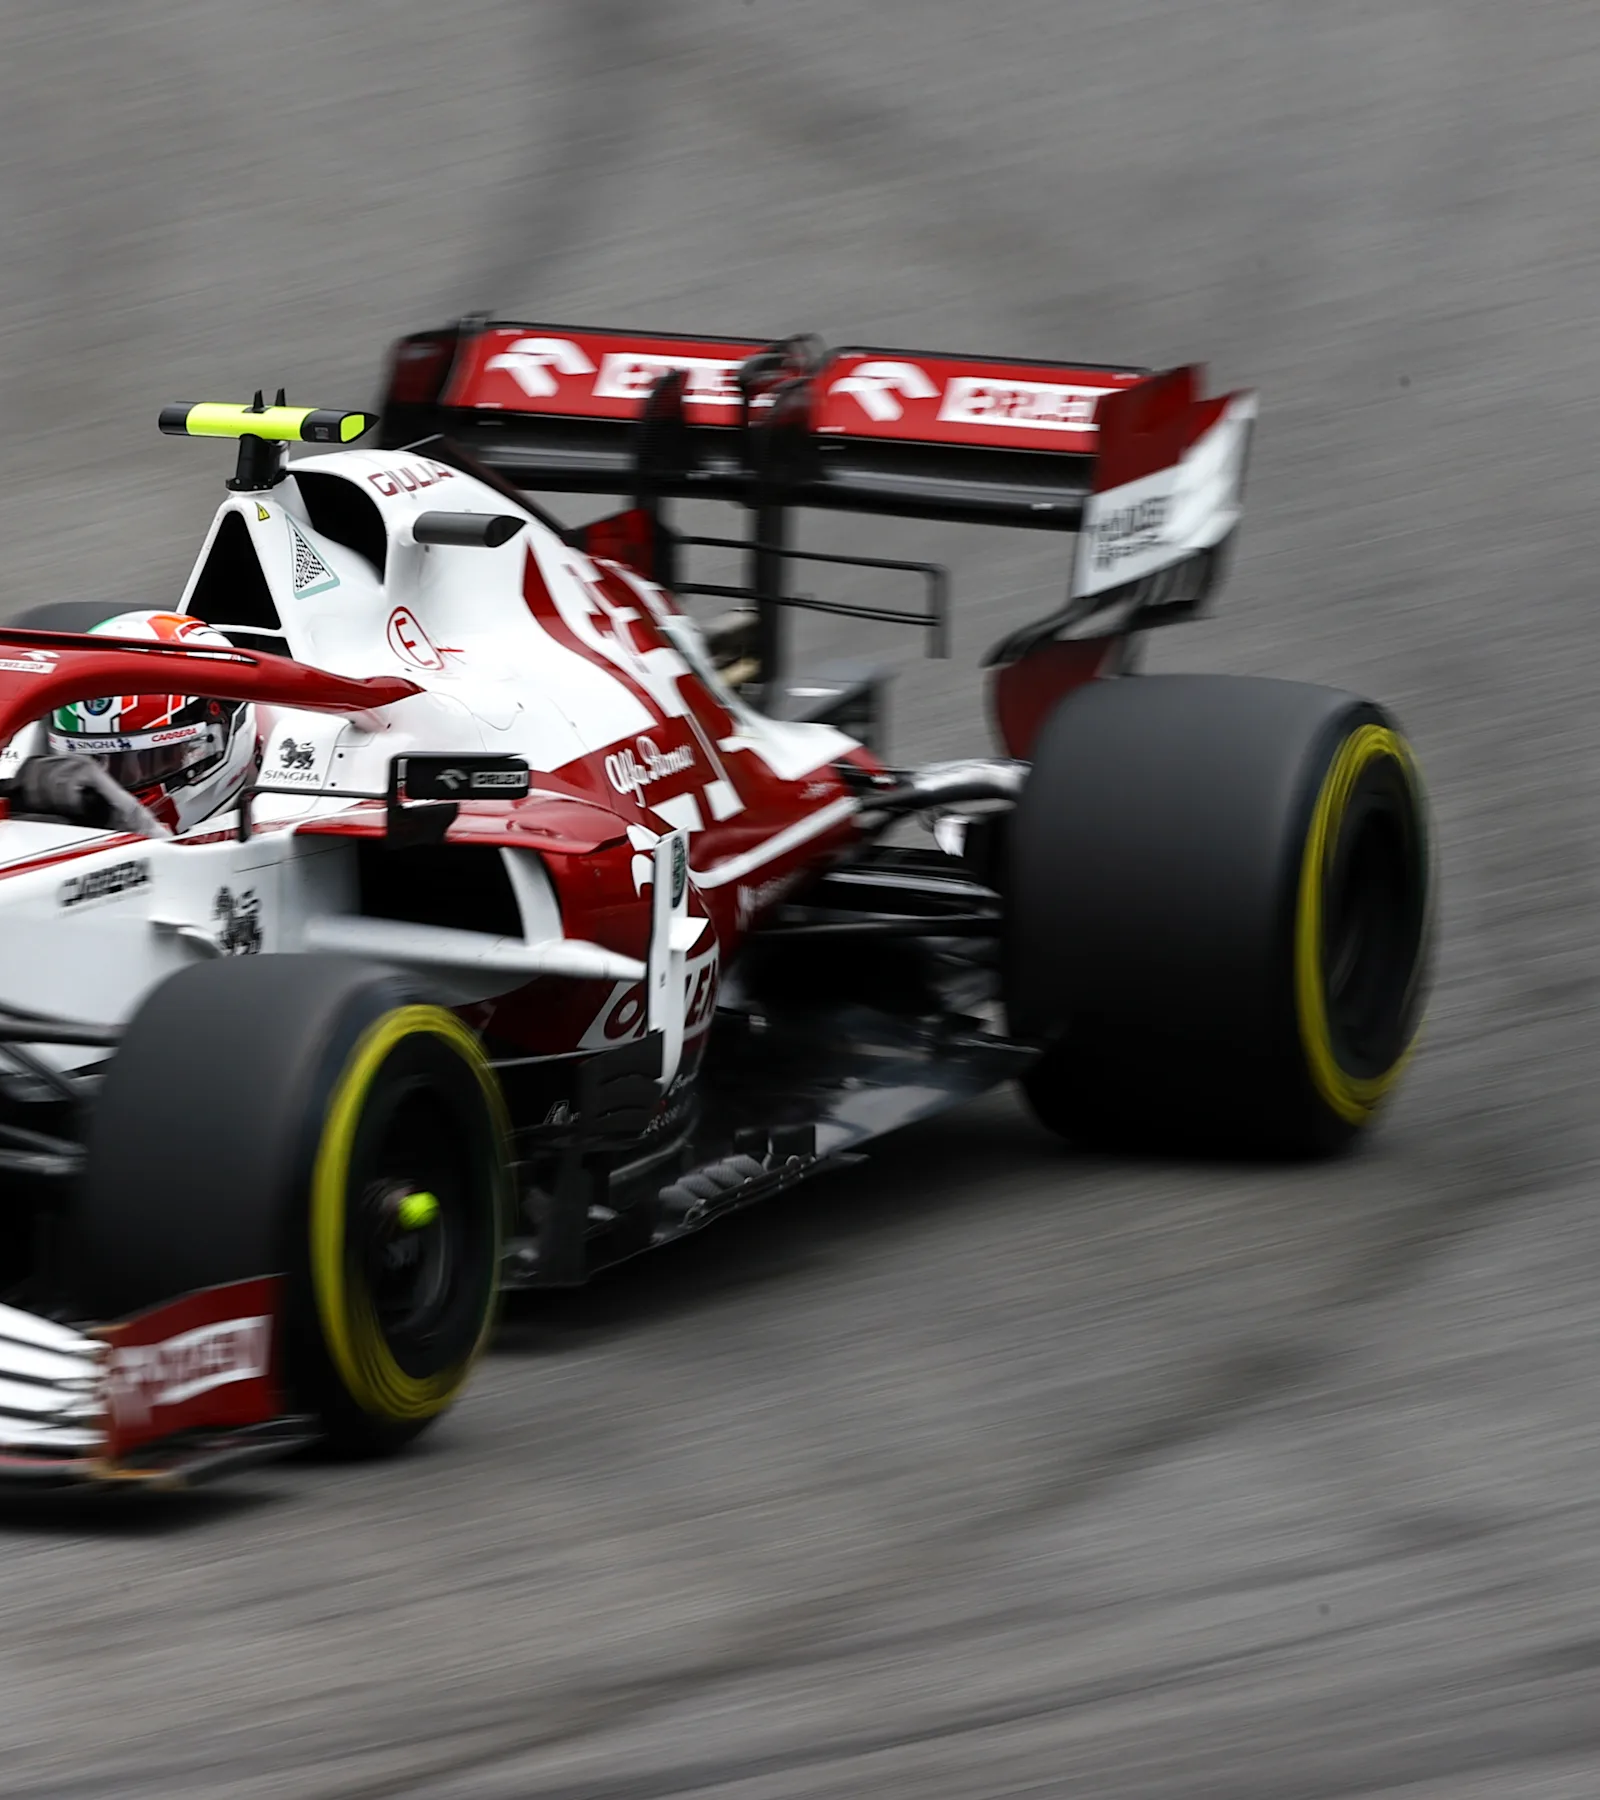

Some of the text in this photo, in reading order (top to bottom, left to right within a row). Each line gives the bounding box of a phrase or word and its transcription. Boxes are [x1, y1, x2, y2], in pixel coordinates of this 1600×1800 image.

[367, 461, 456, 497] GIULIA
[152, 728, 198, 743] CARRERA
[77, 740, 116, 749] SINGHA
[263, 769, 321, 783] SINGHA
